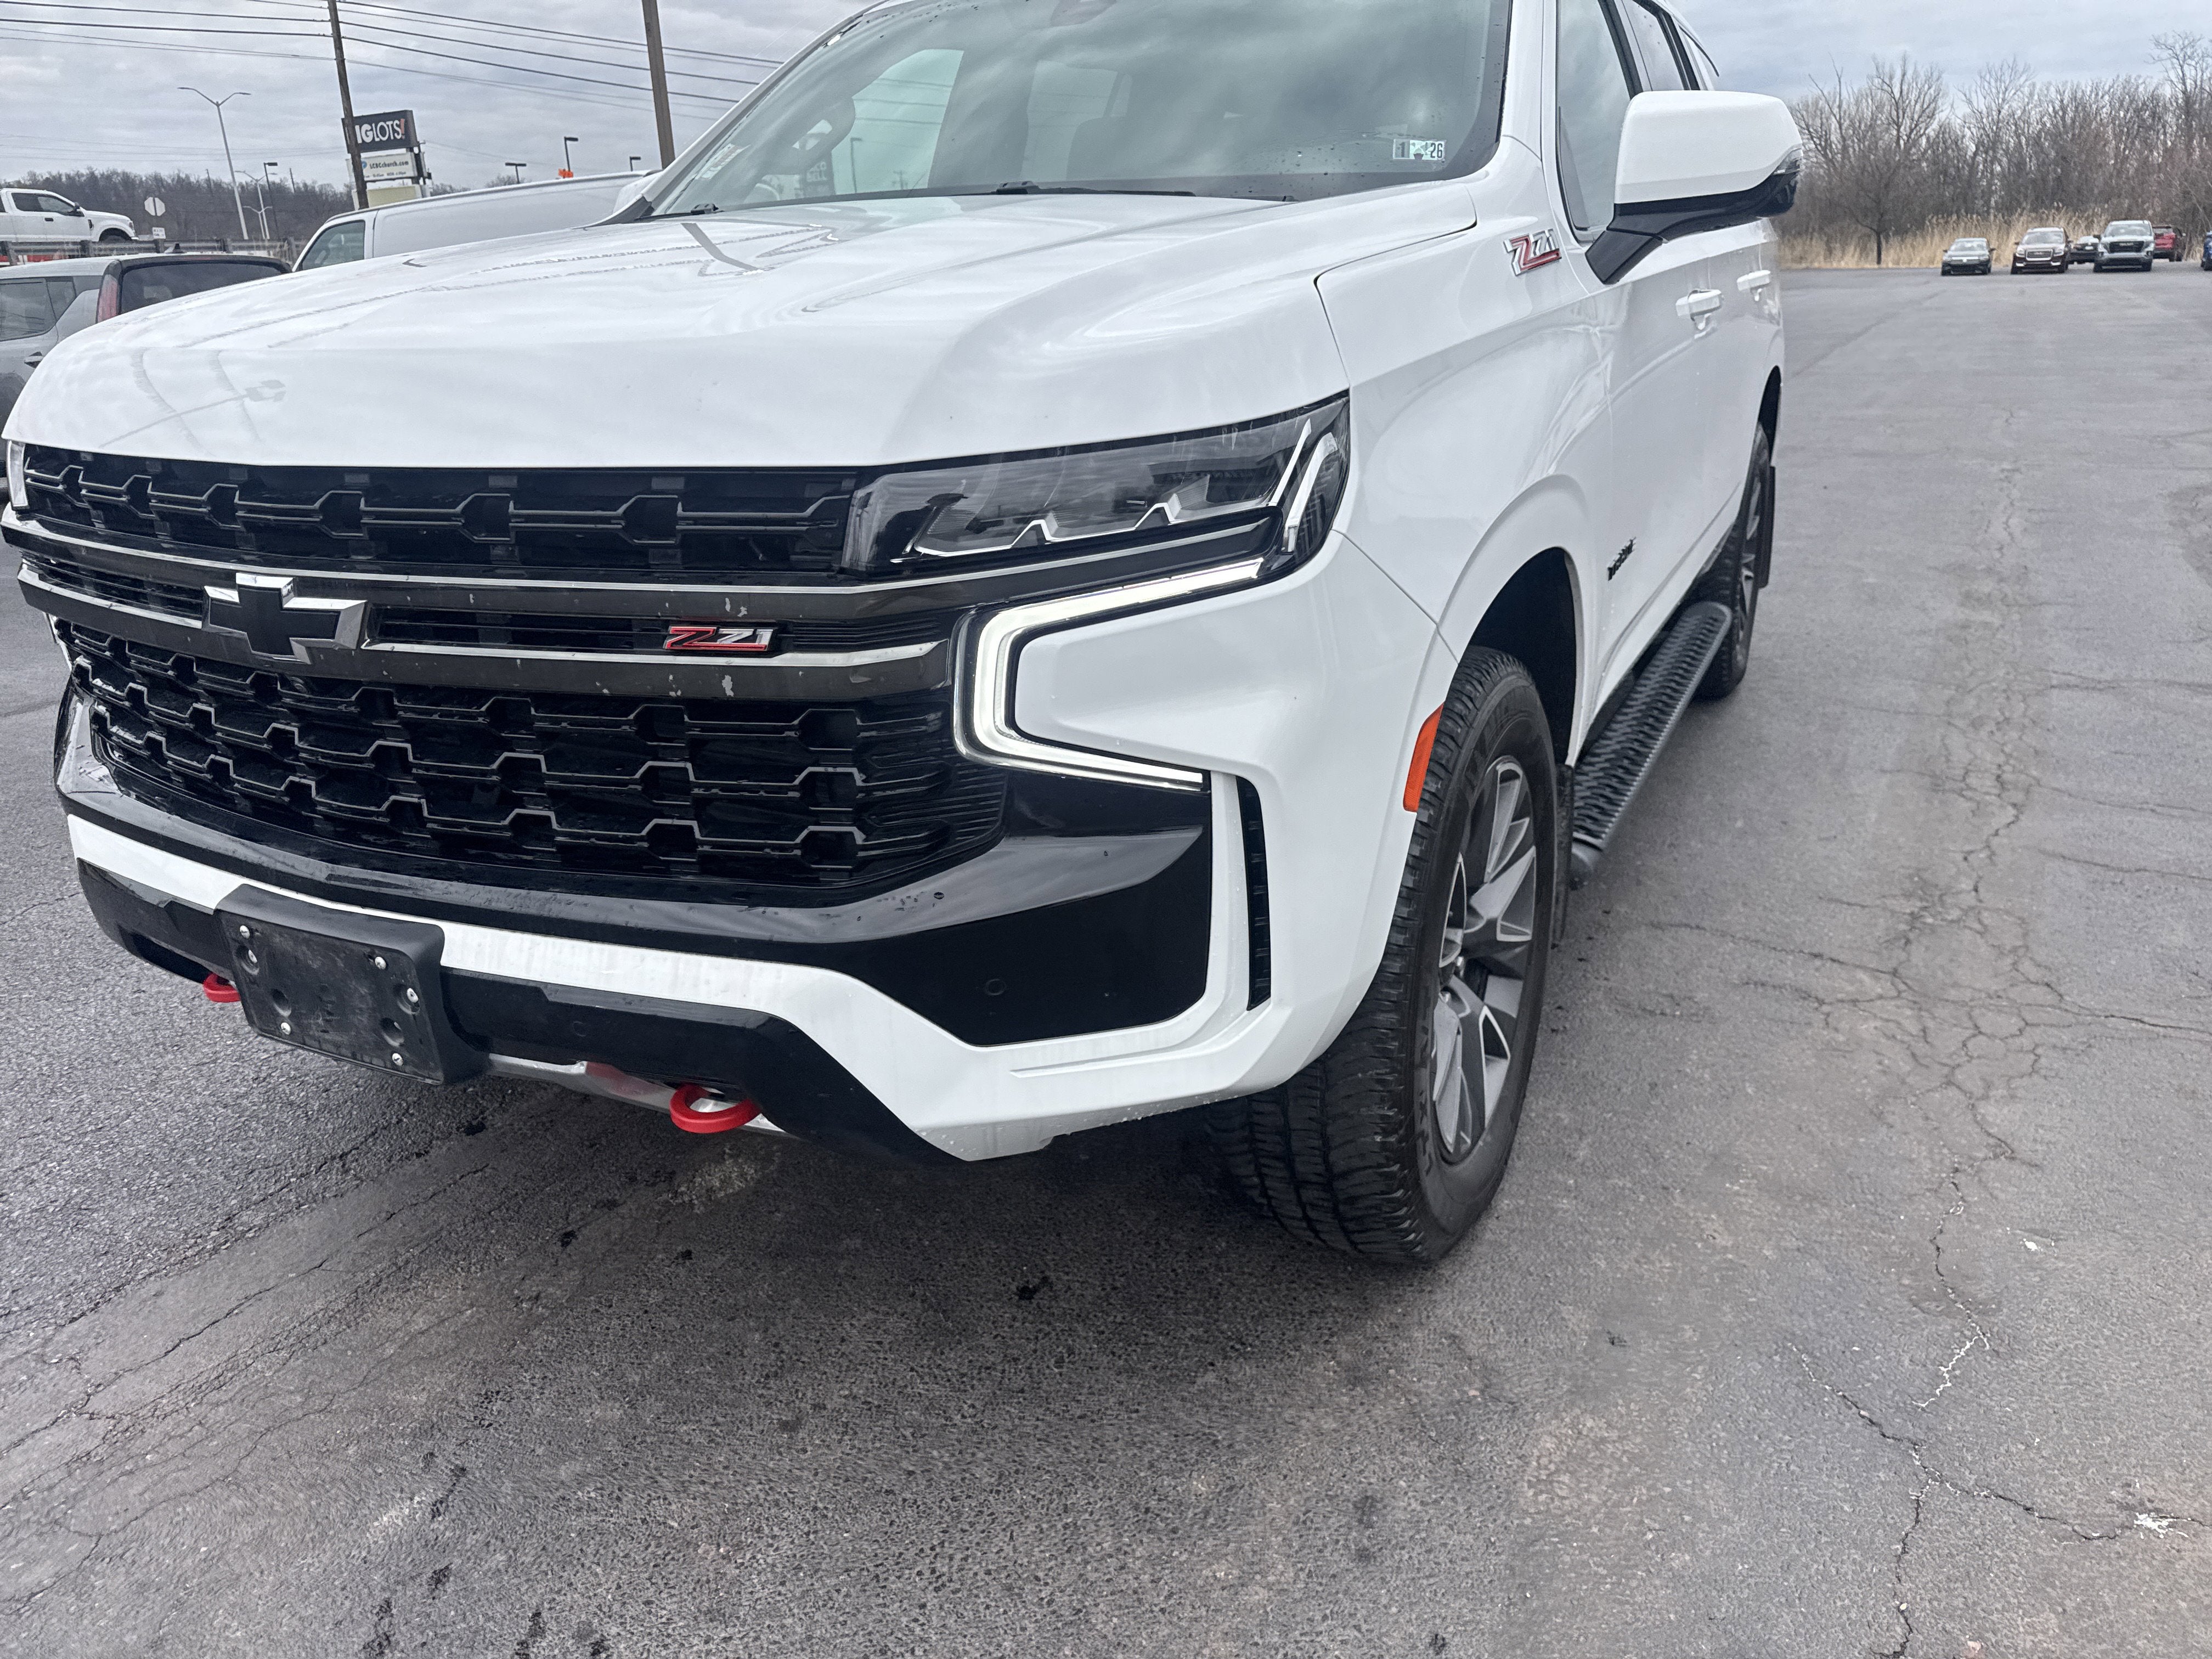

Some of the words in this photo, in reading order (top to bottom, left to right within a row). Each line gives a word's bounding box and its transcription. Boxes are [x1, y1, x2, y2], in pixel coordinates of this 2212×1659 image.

[1430, 143, 1443, 159] 26
[1503, 228, 1562, 276] Z71
[663, 625, 774, 651] Z71
